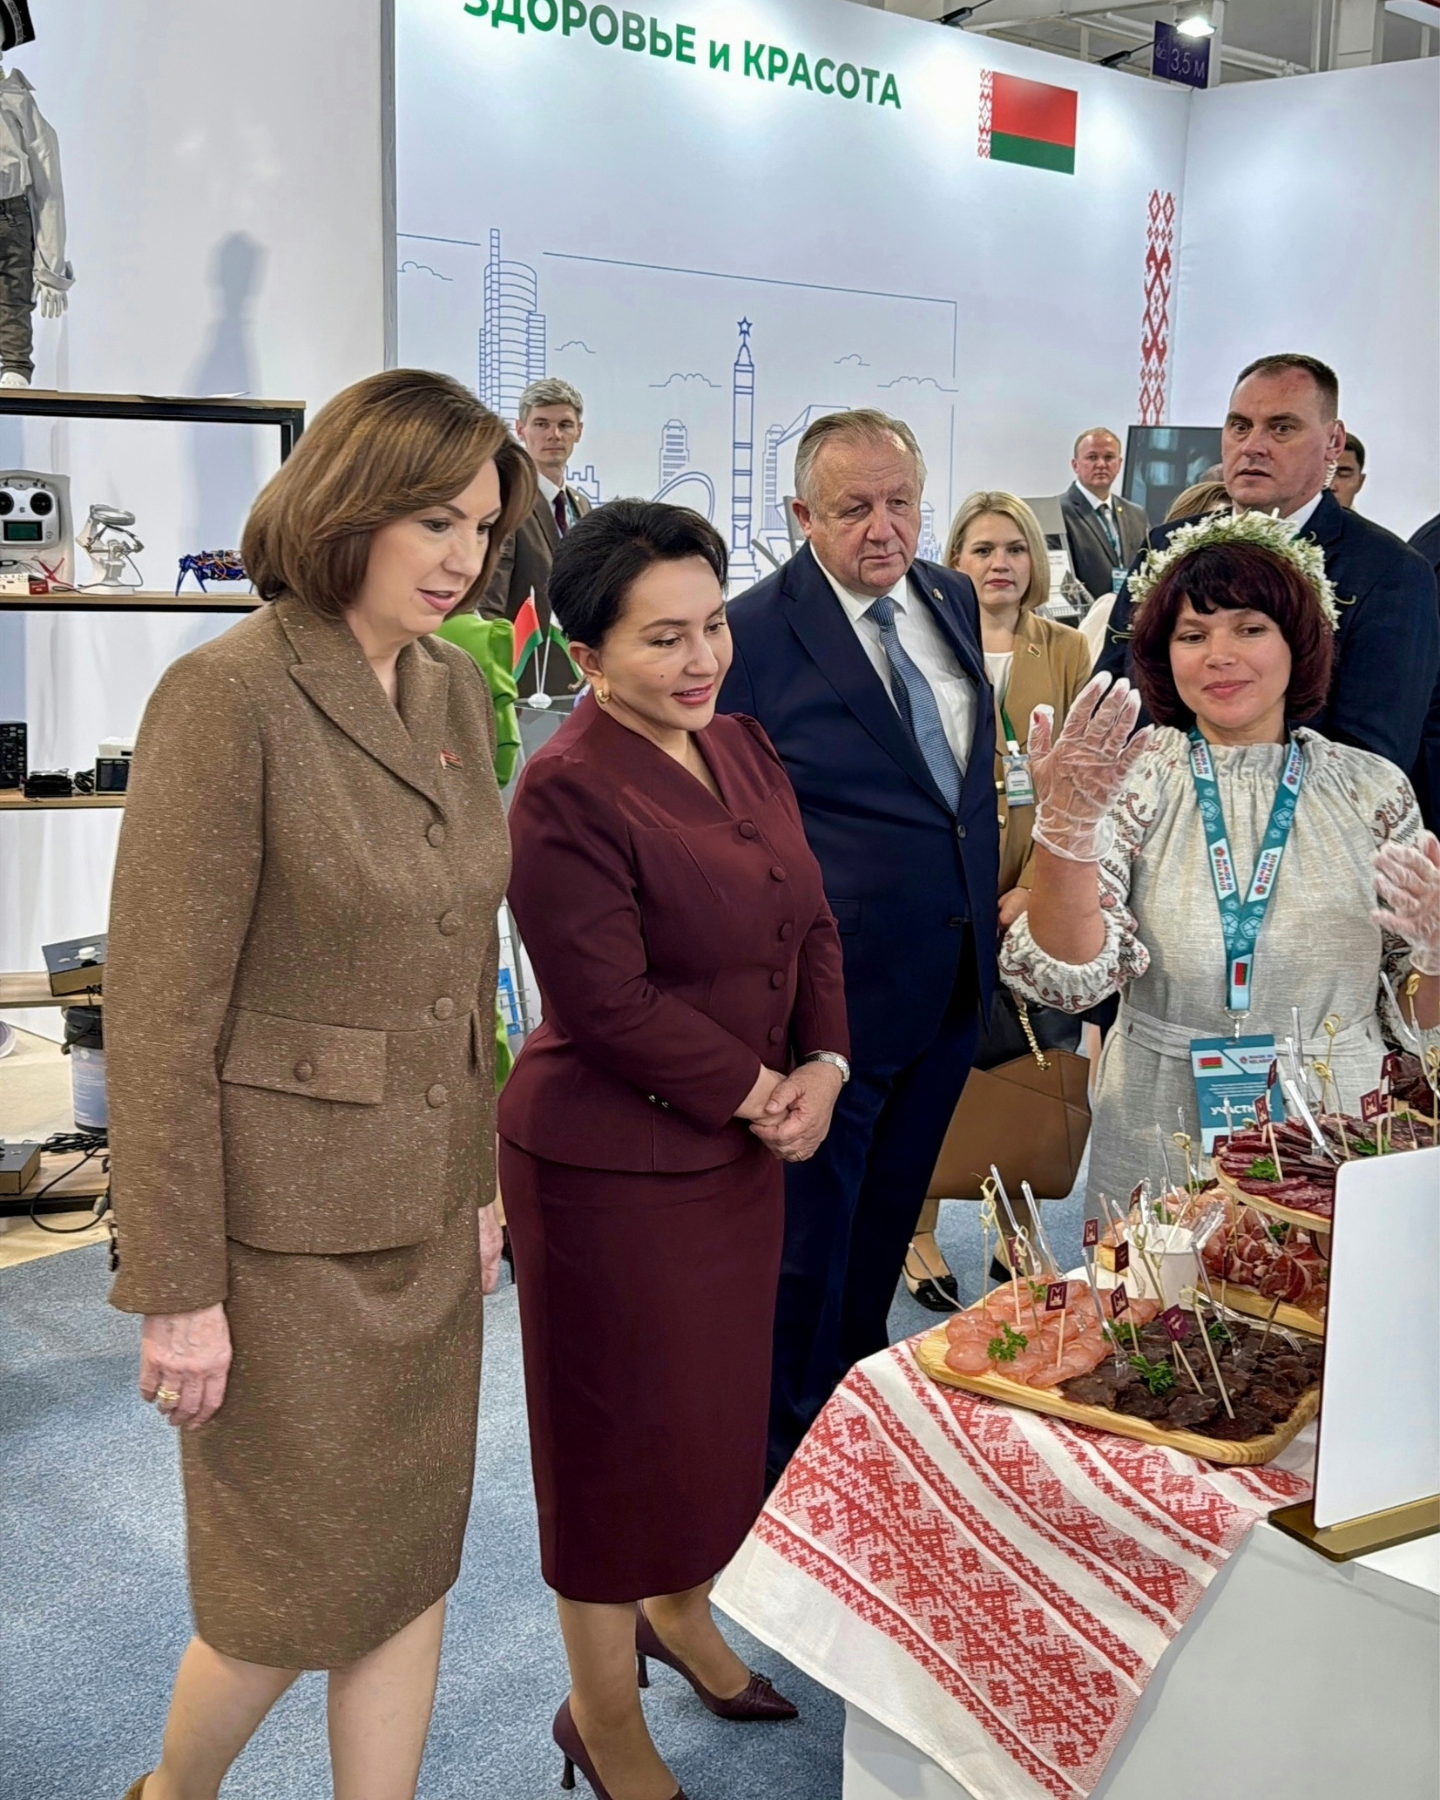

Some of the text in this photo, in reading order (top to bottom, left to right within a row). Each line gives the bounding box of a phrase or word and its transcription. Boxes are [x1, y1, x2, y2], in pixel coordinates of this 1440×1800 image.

[743, 39, 902, 110] КРАСОТА
[1214, 858, 1228, 892] BELARUS
[1263, 854, 1278, 885] BELARUS
[1209, 1104, 1274, 1116] УЧАСТНК
